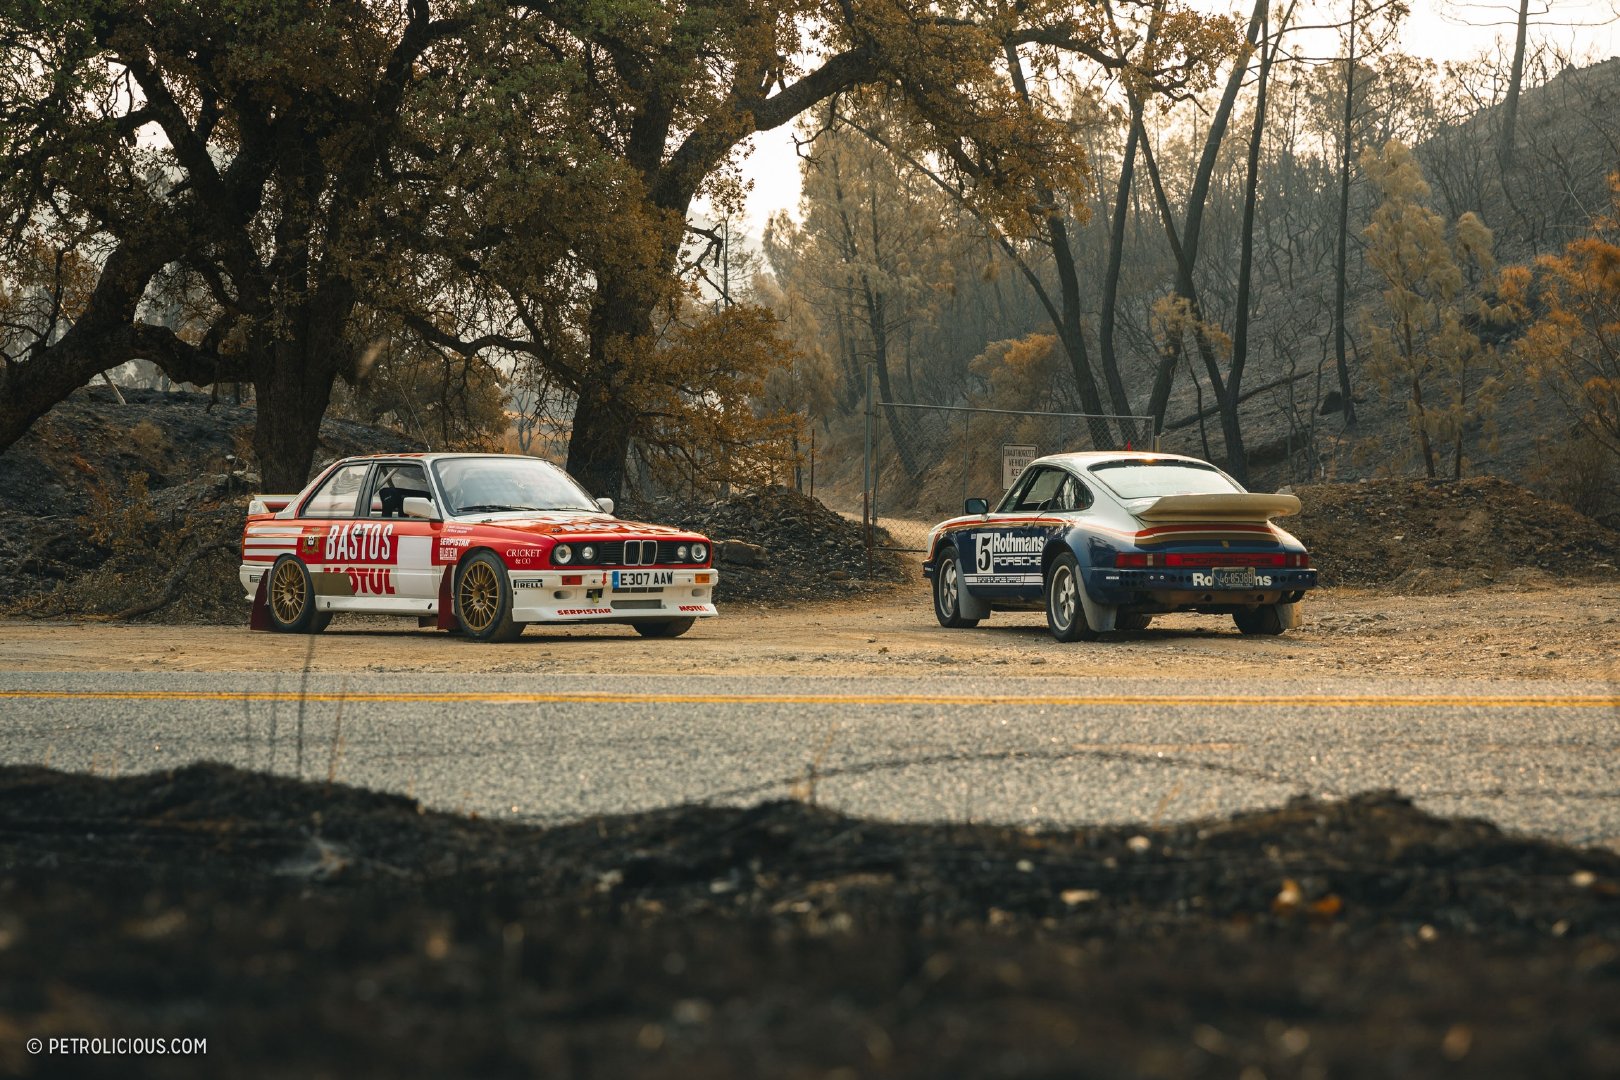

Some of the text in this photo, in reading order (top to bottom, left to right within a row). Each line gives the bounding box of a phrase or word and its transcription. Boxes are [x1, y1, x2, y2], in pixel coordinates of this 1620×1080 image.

[325, 523, 394, 560] BASTOS
[440, 537, 470, 547] SERPISTAR
[993, 532, 1045, 553] Rothmans
[506, 549, 542, 558] CRICKET
[977, 536, 992, 572] 5
[993, 556, 1042, 566] PORSCHE
[621, 572, 673, 585] E307 AAW
[513, 579, 543, 589] PIRELLI
[557, 608, 612, 616] SERPISTAR
